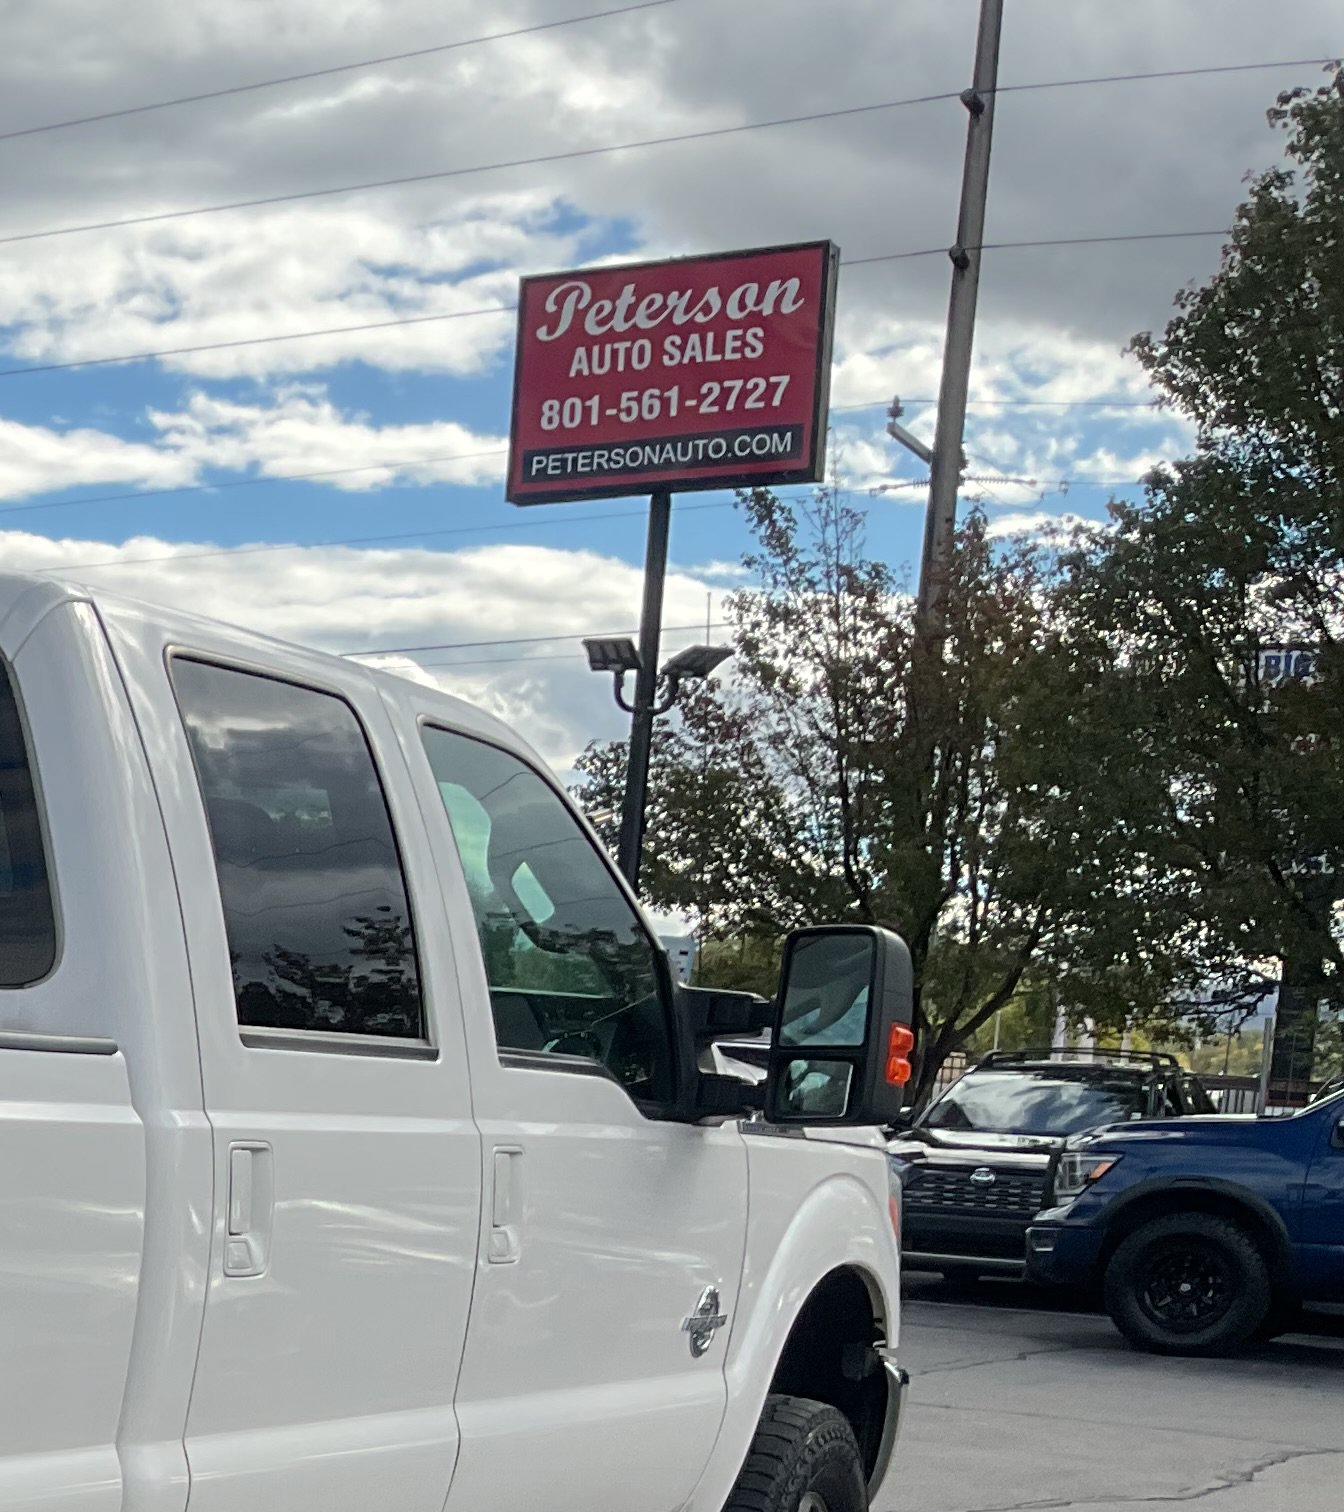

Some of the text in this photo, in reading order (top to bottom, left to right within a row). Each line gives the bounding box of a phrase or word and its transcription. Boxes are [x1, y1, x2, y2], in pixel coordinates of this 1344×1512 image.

[535, 276, 805, 342] Peterson
[569, 326, 765, 378] AUTO SALES
[540, 375, 791, 431] 801-561-2727
[531, 431, 793, 477] PETERSONAUTO.COM
